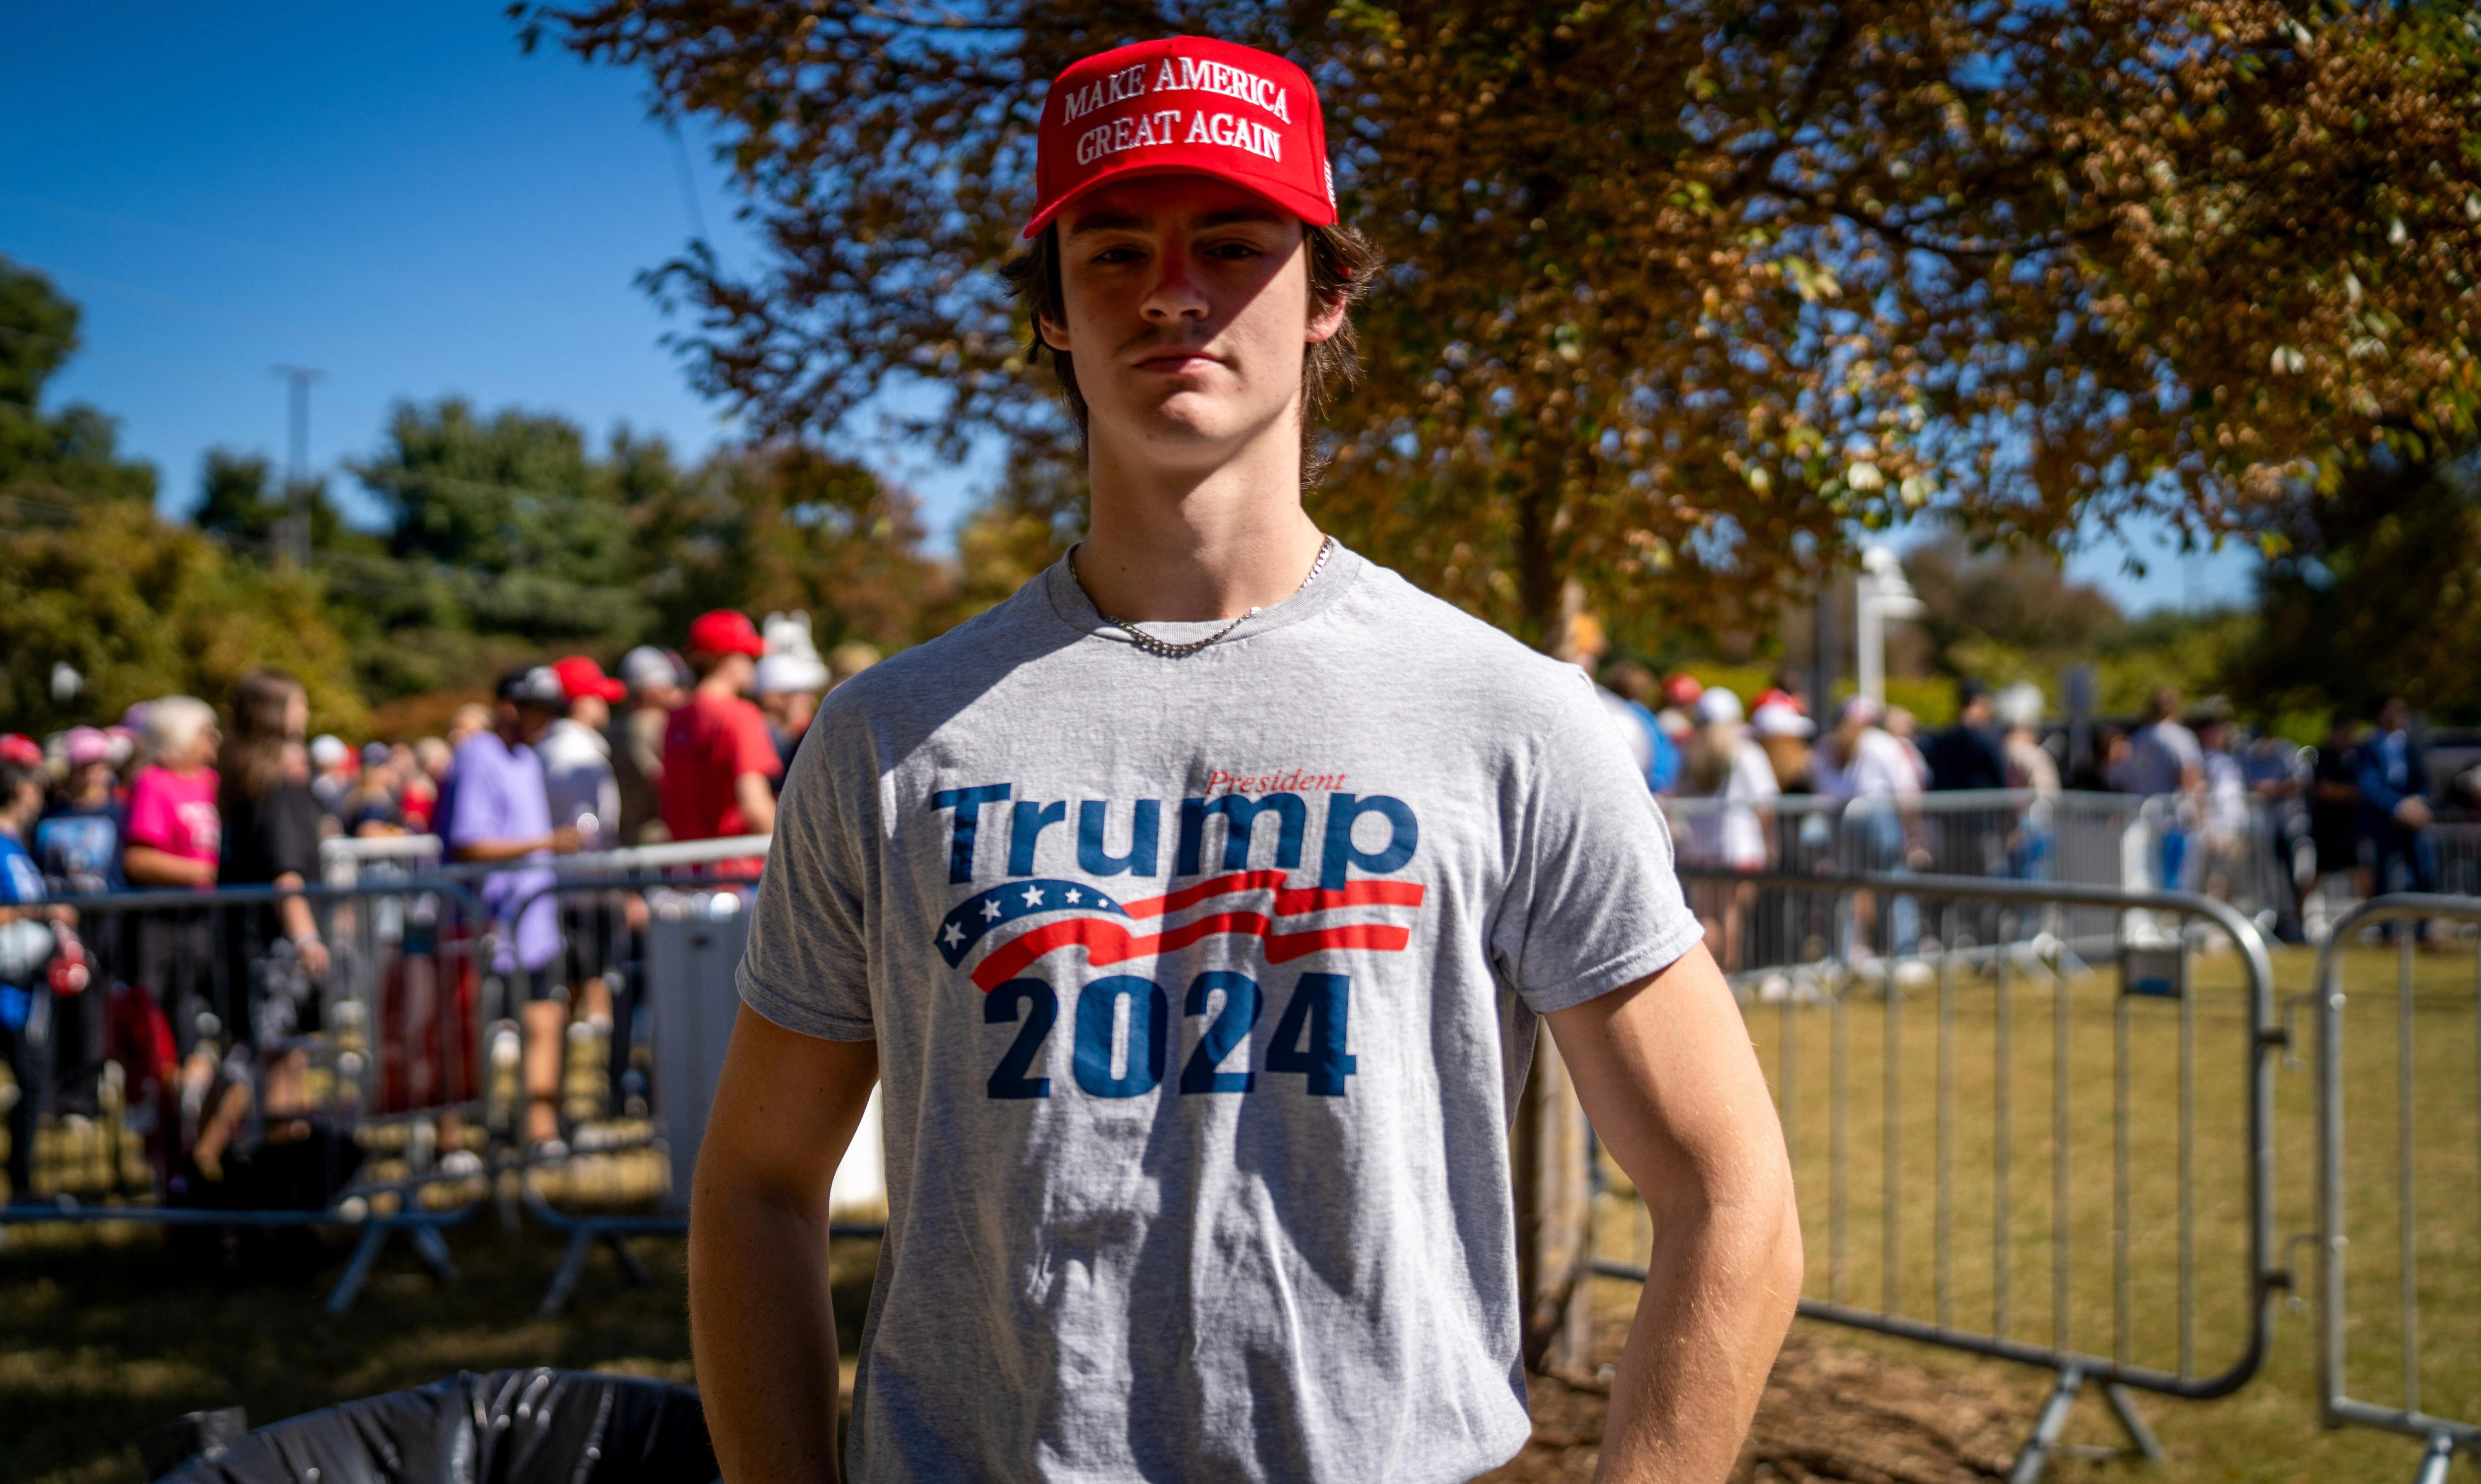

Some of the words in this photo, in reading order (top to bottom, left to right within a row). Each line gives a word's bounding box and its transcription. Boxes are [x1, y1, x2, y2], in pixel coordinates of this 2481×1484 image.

[1063, 64, 1146, 126] MAKE
[1152, 56, 1291, 125] AMERICA
[1076, 110, 1181, 165] GREAT
[1183, 110, 1282, 163] AGAIN
[1204, 768, 1347, 795] President
[930, 783, 1418, 891] Trump
[984, 971, 1356, 1098] 2024
